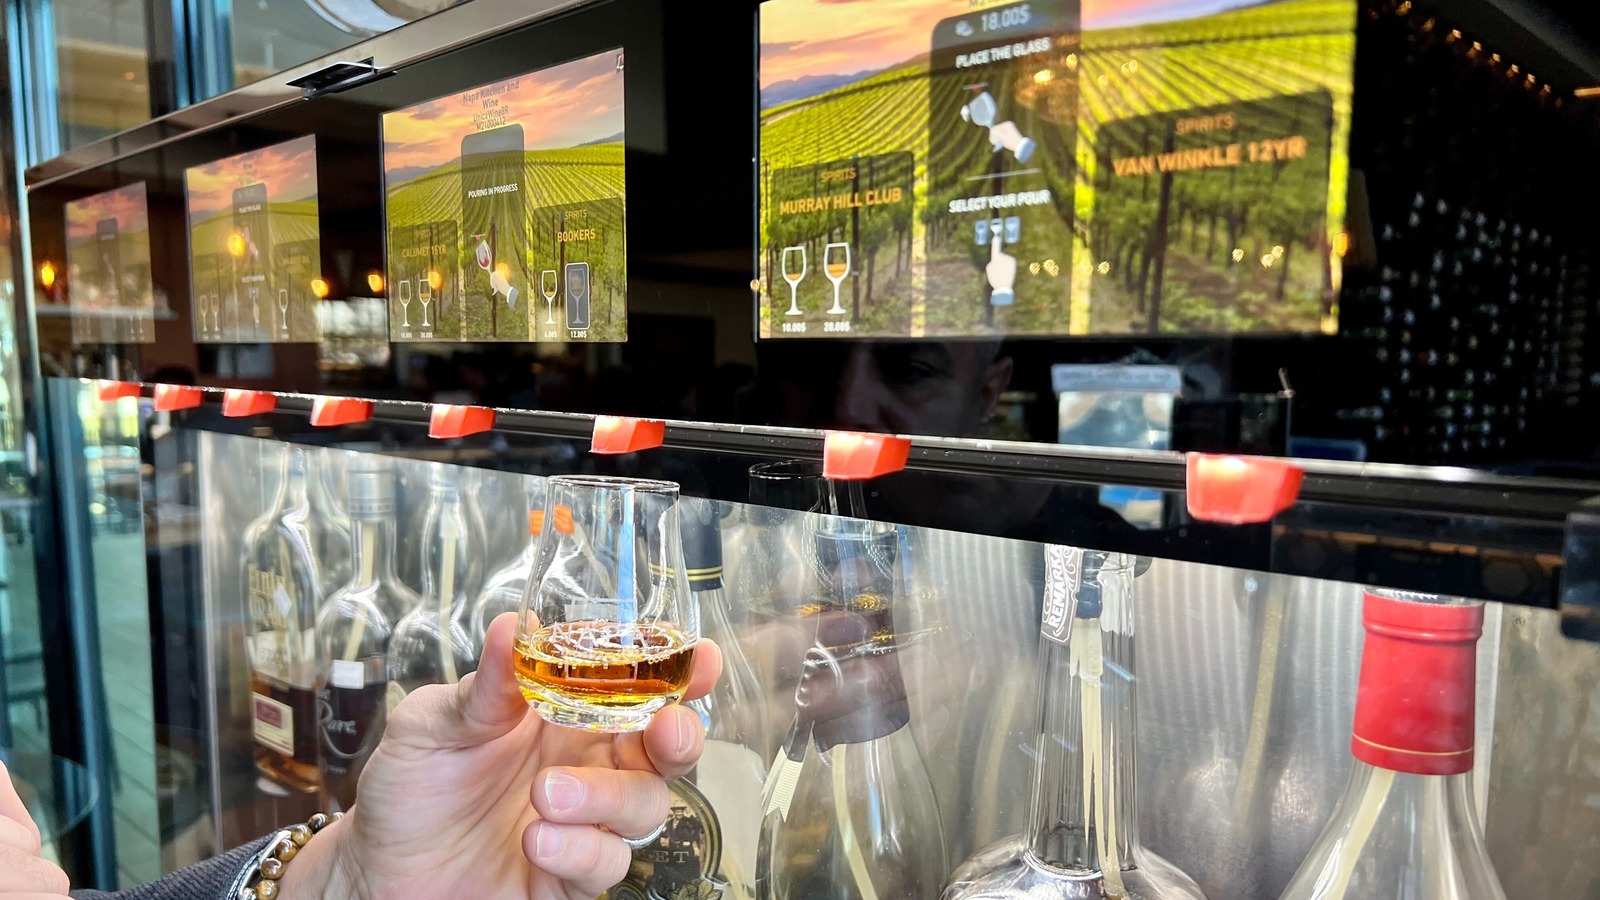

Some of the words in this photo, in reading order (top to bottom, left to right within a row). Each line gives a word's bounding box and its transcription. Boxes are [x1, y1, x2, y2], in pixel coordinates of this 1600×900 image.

[981, 4, 1030, 32] 18.00$
[955, 49, 989, 68] PLACE
[990, 45, 1012, 61] THE
[1012, 36, 1051, 57] GLASS
[463, 91, 479, 105] Napa
[480, 84, 506, 99] Kitchen
[506, 80, 519, 92] and
[482, 98, 499, 109] Wine
[1176, 113, 1235, 135] SPIRITS
[1113, 156, 1155, 177] VAN
[1157, 143, 1242, 173] WINKLE
[1247, 135, 1308, 163] 12YR
[821, 168, 857, 183] SPIRITS
[468, 188, 487, 198] POURING
[494, 183, 518, 194] PROGRESS
[780, 196, 832, 216] MURRAY
[833, 192, 863, 209] HILL
[865, 187, 903, 206] CLUB
[949, 196, 987, 213] SELECT
[987, 193, 1017, 209] YOUR
[1017, 189, 1051, 206] POUR
[565, 209, 588, 220] SPIRITS
[557, 228, 596, 243] BOOKERS
